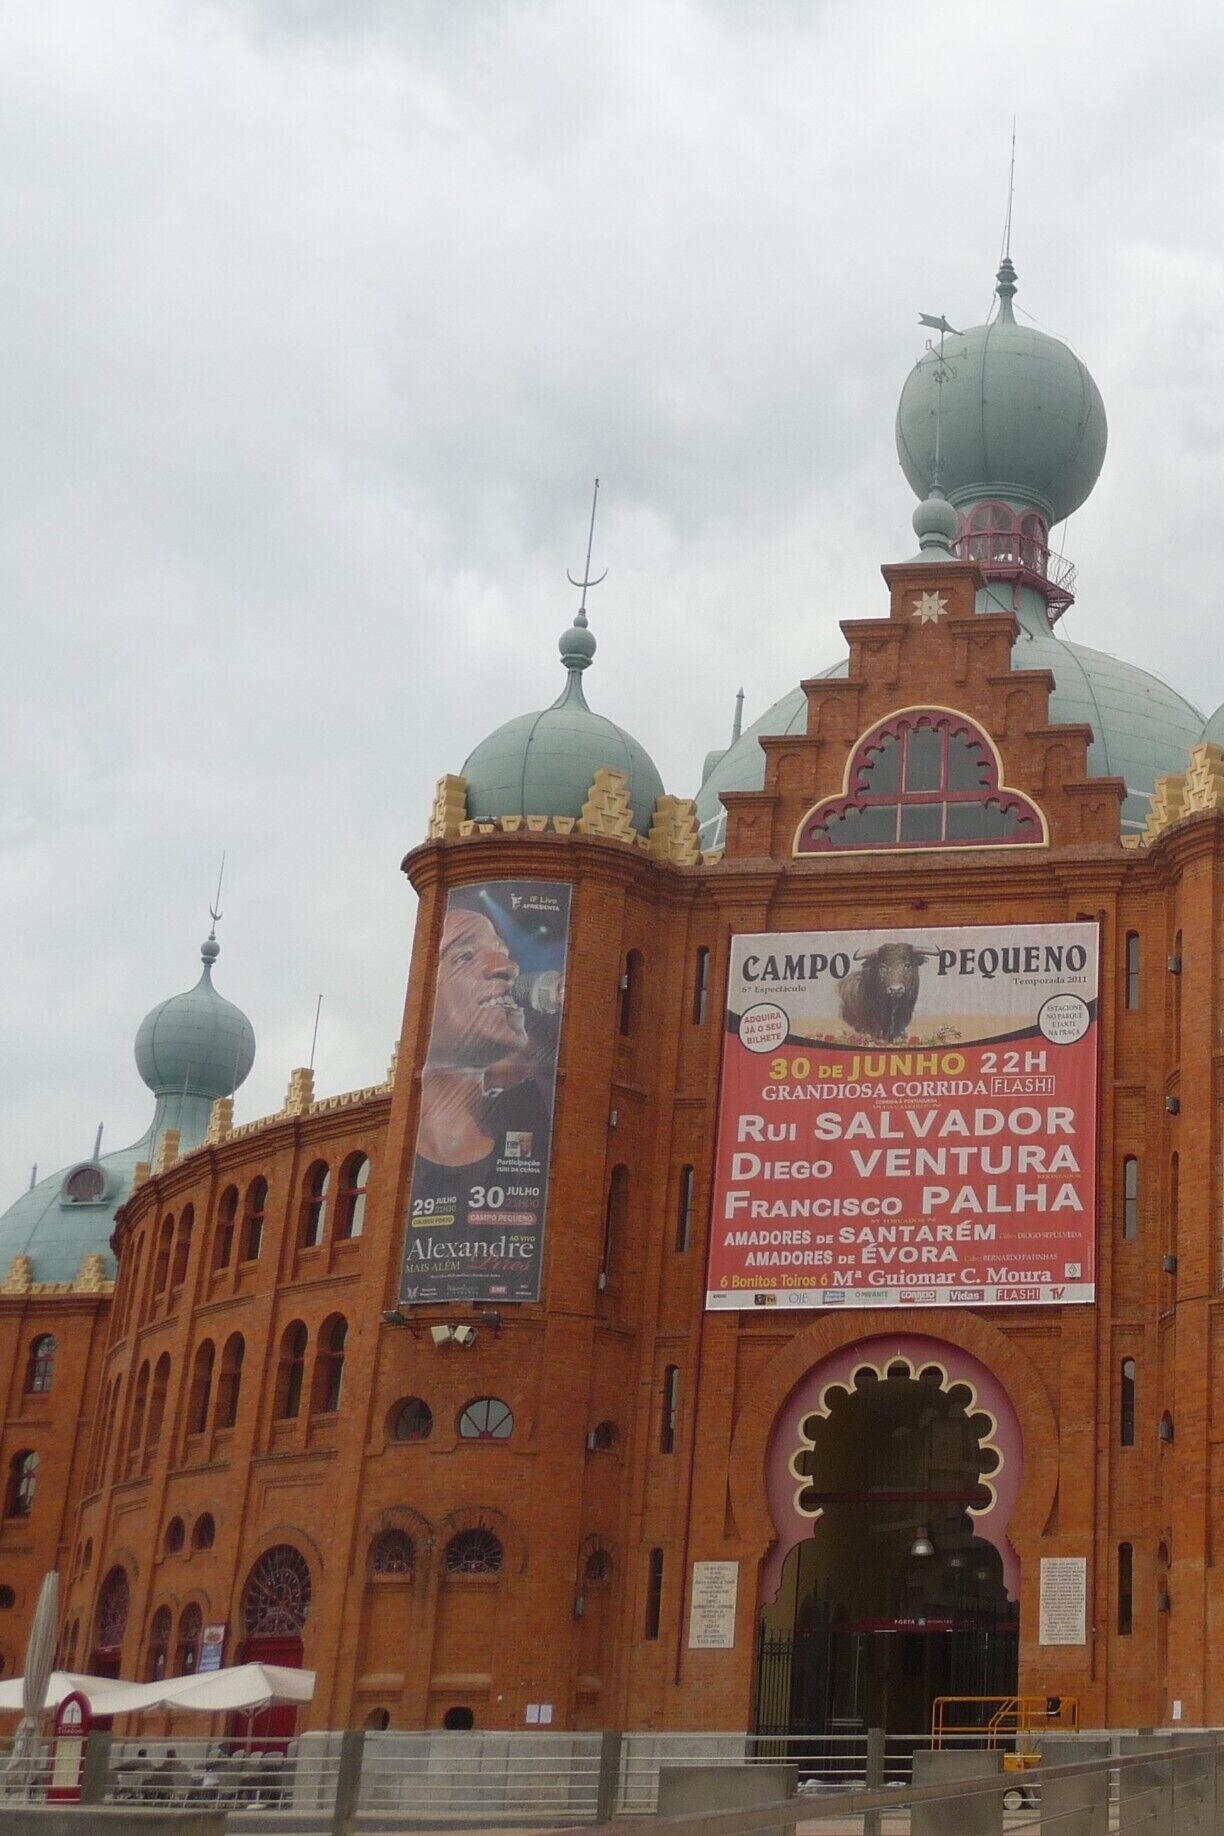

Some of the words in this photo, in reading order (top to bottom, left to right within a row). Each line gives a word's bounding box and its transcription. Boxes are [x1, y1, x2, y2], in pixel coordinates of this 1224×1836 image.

[742, 952, 851, 982] CAMPO
[937, 944, 1087, 979] PEQUENO
[1012, 976, 1065, 987] Temporada
[1067, 975, 1087, 984] 2011
[744, 1012, 782, 1024] ADQUIRA
[1046, 1004, 1083, 1012] ESTACIONE
[746, 1032, 782, 1045] BILHETE
[766, 1023, 782, 1032] SEU
[769, 1057, 811, 1080] 30
[818, 1065, 843, 1078] DE
[847, 1052, 966, 1081] JUNHO
[980, 1050, 1047, 1074] 22H
[761, 1083, 888, 1101] GRANDIOSA
[891, 1080, 988, 1097] CORRIDA
[993, 1078, 1052, 1093] FLASH!
[814, 1106, 1076, 1141] SALVADOR
[850, 1144, 1081, 1178] VENTURA
[412, 1198, 435, 1216] 29
[435, 1196, 457, 1205] JULHO
[468, 1185, 505, 1209] 30
[506, 1186, 540, 1197] JULHO
[922, 1183, 1084, 1215] PALHA
[470, 1214, 497, 1222] CAMPO
[724, 1230, 811, 1246] AMADORES
[816, 1234, 834, 1244] DE
[839, 1219, 996, 1244] SANTARÉM
[407, 1235, 534, 1261] Alexandre
[745, 1250, 833, 1267] AMADORES
[838, 1255, 856, 1265] DE
[861, 1243, 959, 1264] ÉVORA
[404, 1262, 430, 1274] MAIS
[430, 1259, 461, 1273] ALÉM
[720, 1275, 728, 1288] 6
[732, 1275, 778, 1288] Bonitos
[781, 1273, 817, 1287] Toiros
[820, 1273, 828, 1287] 6
[868, 1269, 956, 1286] Guiomar
[960, 1267, 980, 1284] C.
[986, 1267, 1052, 1284] Moura
[950, 1290, 980, 1302] Vidas
[997, 1288, 1040, 1301] FLASH!
